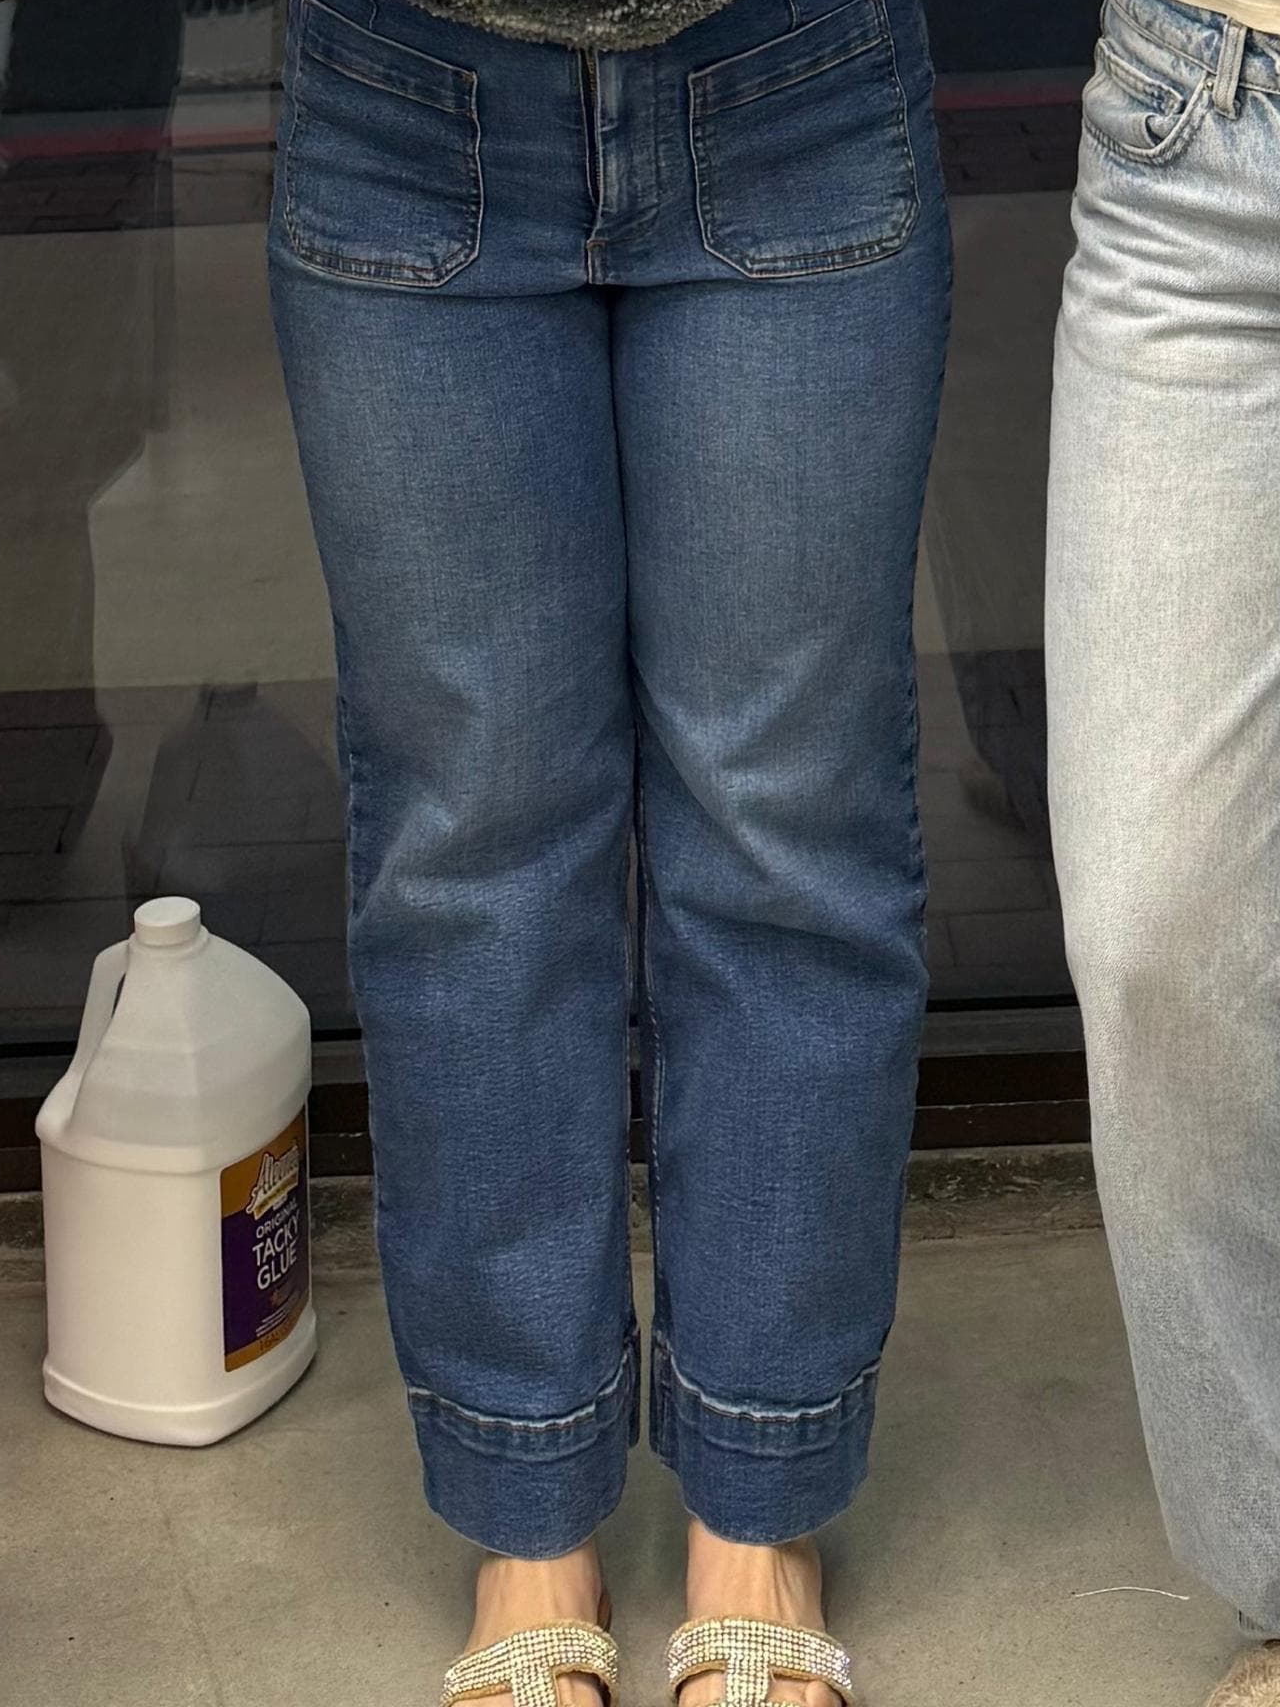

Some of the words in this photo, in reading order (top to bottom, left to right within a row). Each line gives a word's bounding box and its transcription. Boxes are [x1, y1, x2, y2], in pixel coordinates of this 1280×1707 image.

[252, 1209, 301, 1267] TACKY
[255, 1197, 298, 1239] ORIGINAL
[256, 1238, 298, 1291] GLUE
